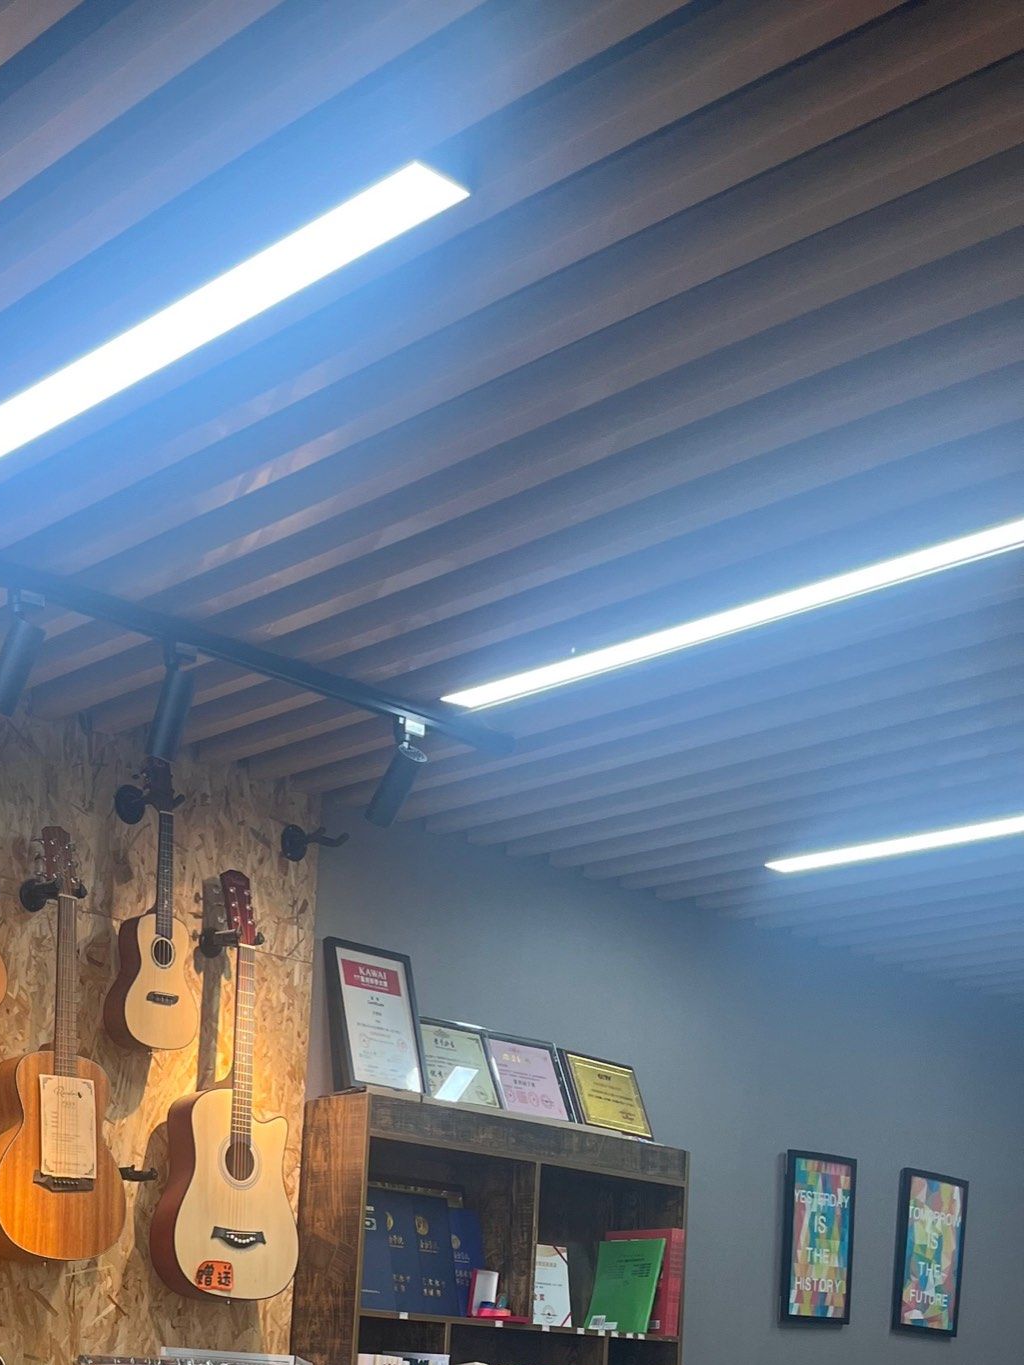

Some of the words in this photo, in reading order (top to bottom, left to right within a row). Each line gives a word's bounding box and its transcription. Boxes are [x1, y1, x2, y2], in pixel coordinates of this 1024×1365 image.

[358, 966, 387, 980] KAWAI
[794, 1189, 850, 1209] YESTERDAY
[814, 1215, 827, 1234] IS
[908, 1205, 962, 1228] TOMORROW
[926, 1232, 939, 1250] IS
[806, 1247, 830, 1263] THE
[197, 1264, 231, 1287] 赠送
[918, 1261, 941, 1277] THE
[795, 1276, 842, 1293] HISTORY
[909, 1289, 948, 1307] FUTURE
